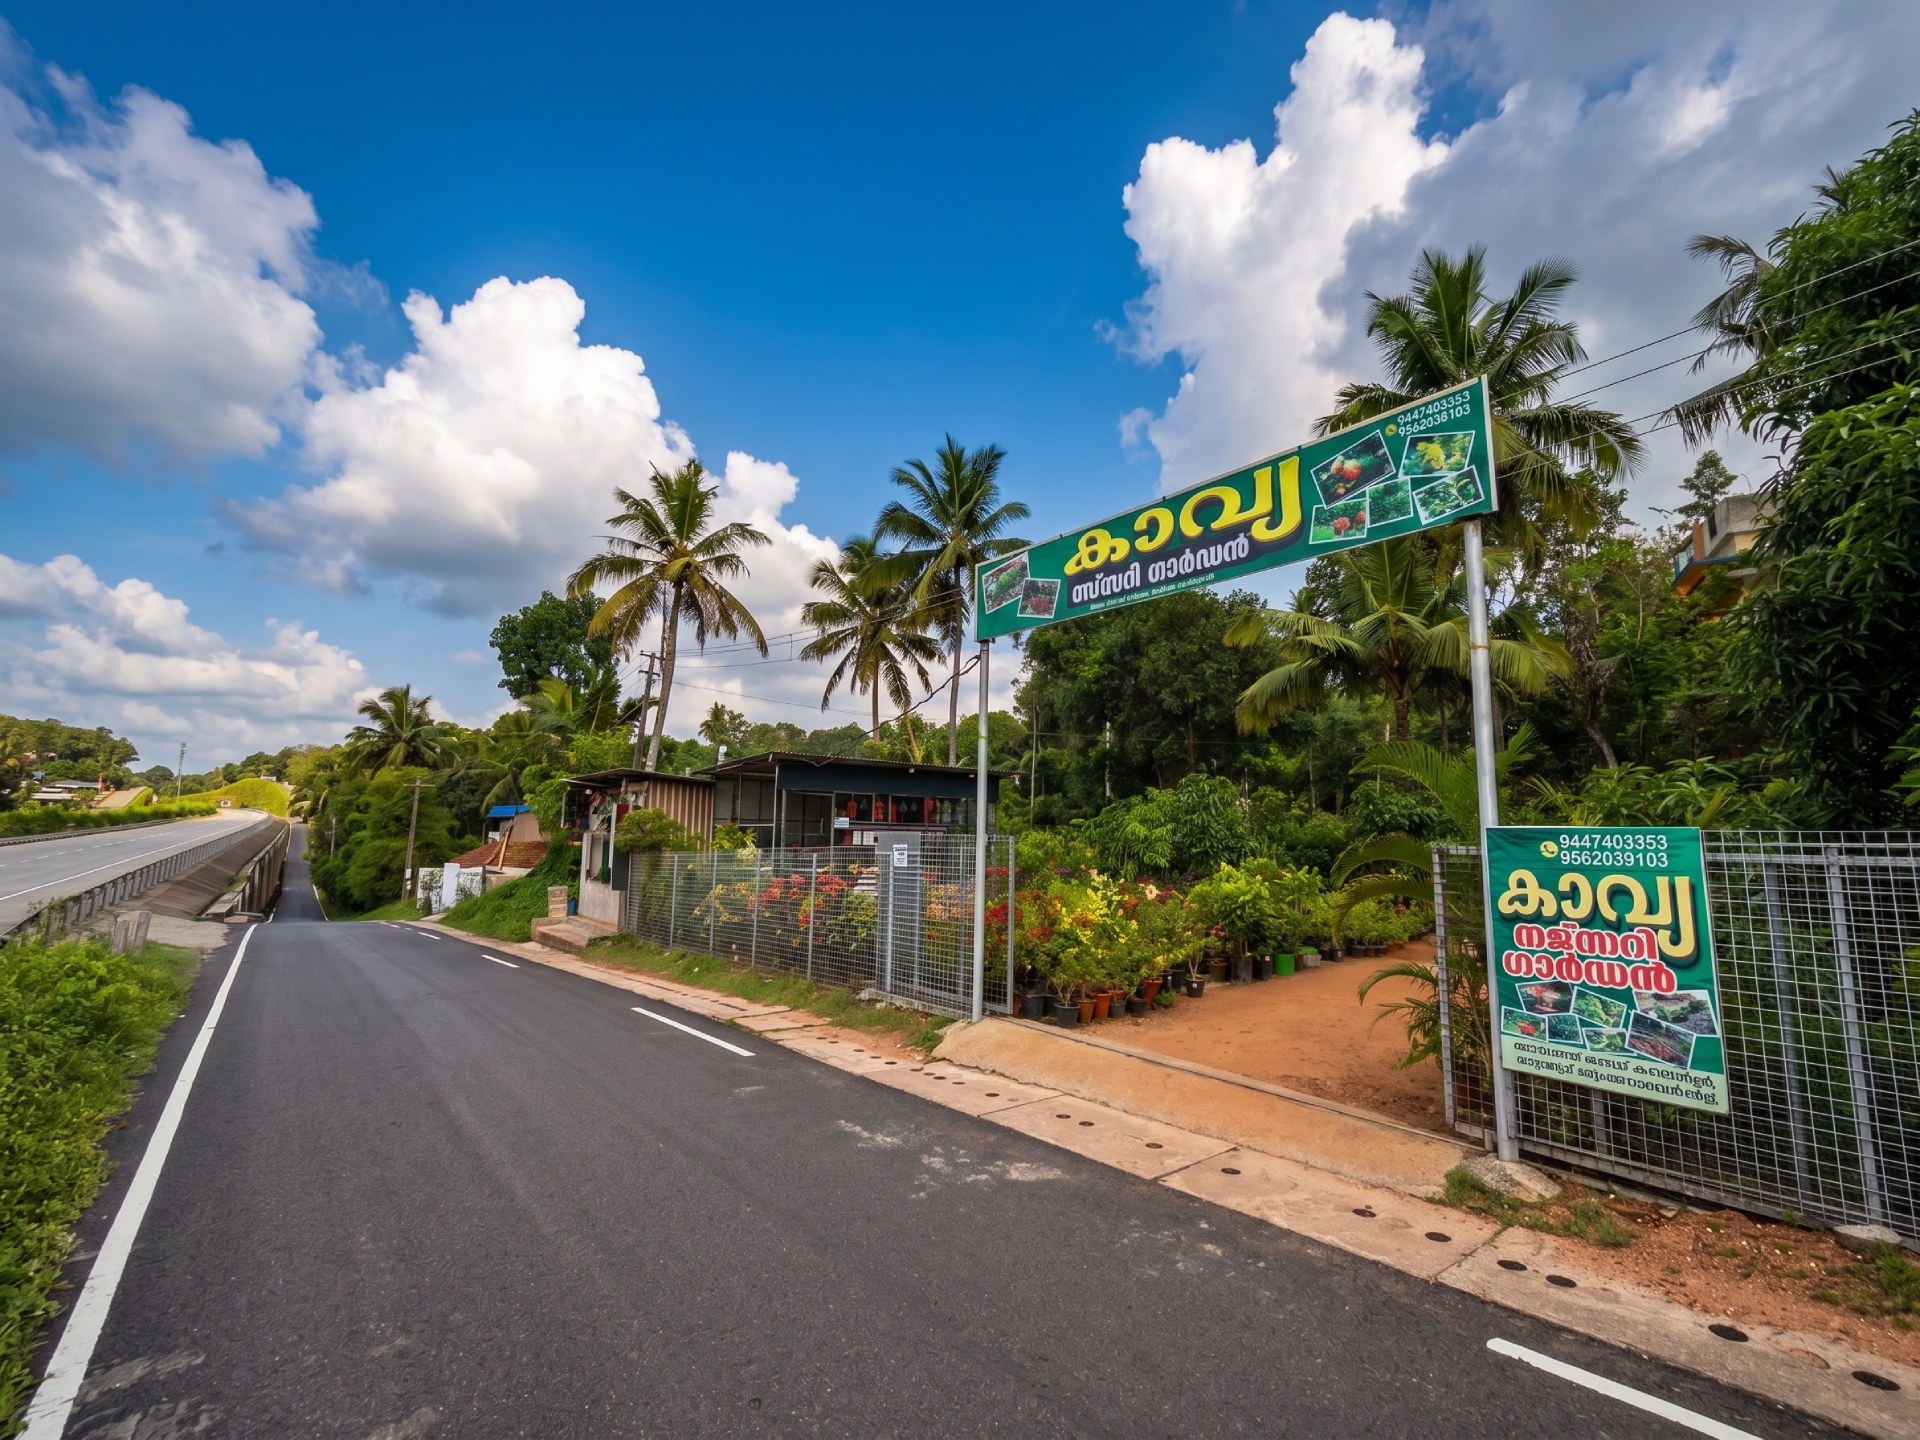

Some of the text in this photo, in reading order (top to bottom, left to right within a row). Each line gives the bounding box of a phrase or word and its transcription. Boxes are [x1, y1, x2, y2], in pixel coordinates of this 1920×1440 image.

[1397, 390, 1471, 426] 9447403353
[1559, 834, 1668, 850] 9447403353
[1560, 850, 1669, 868] 9562039103
